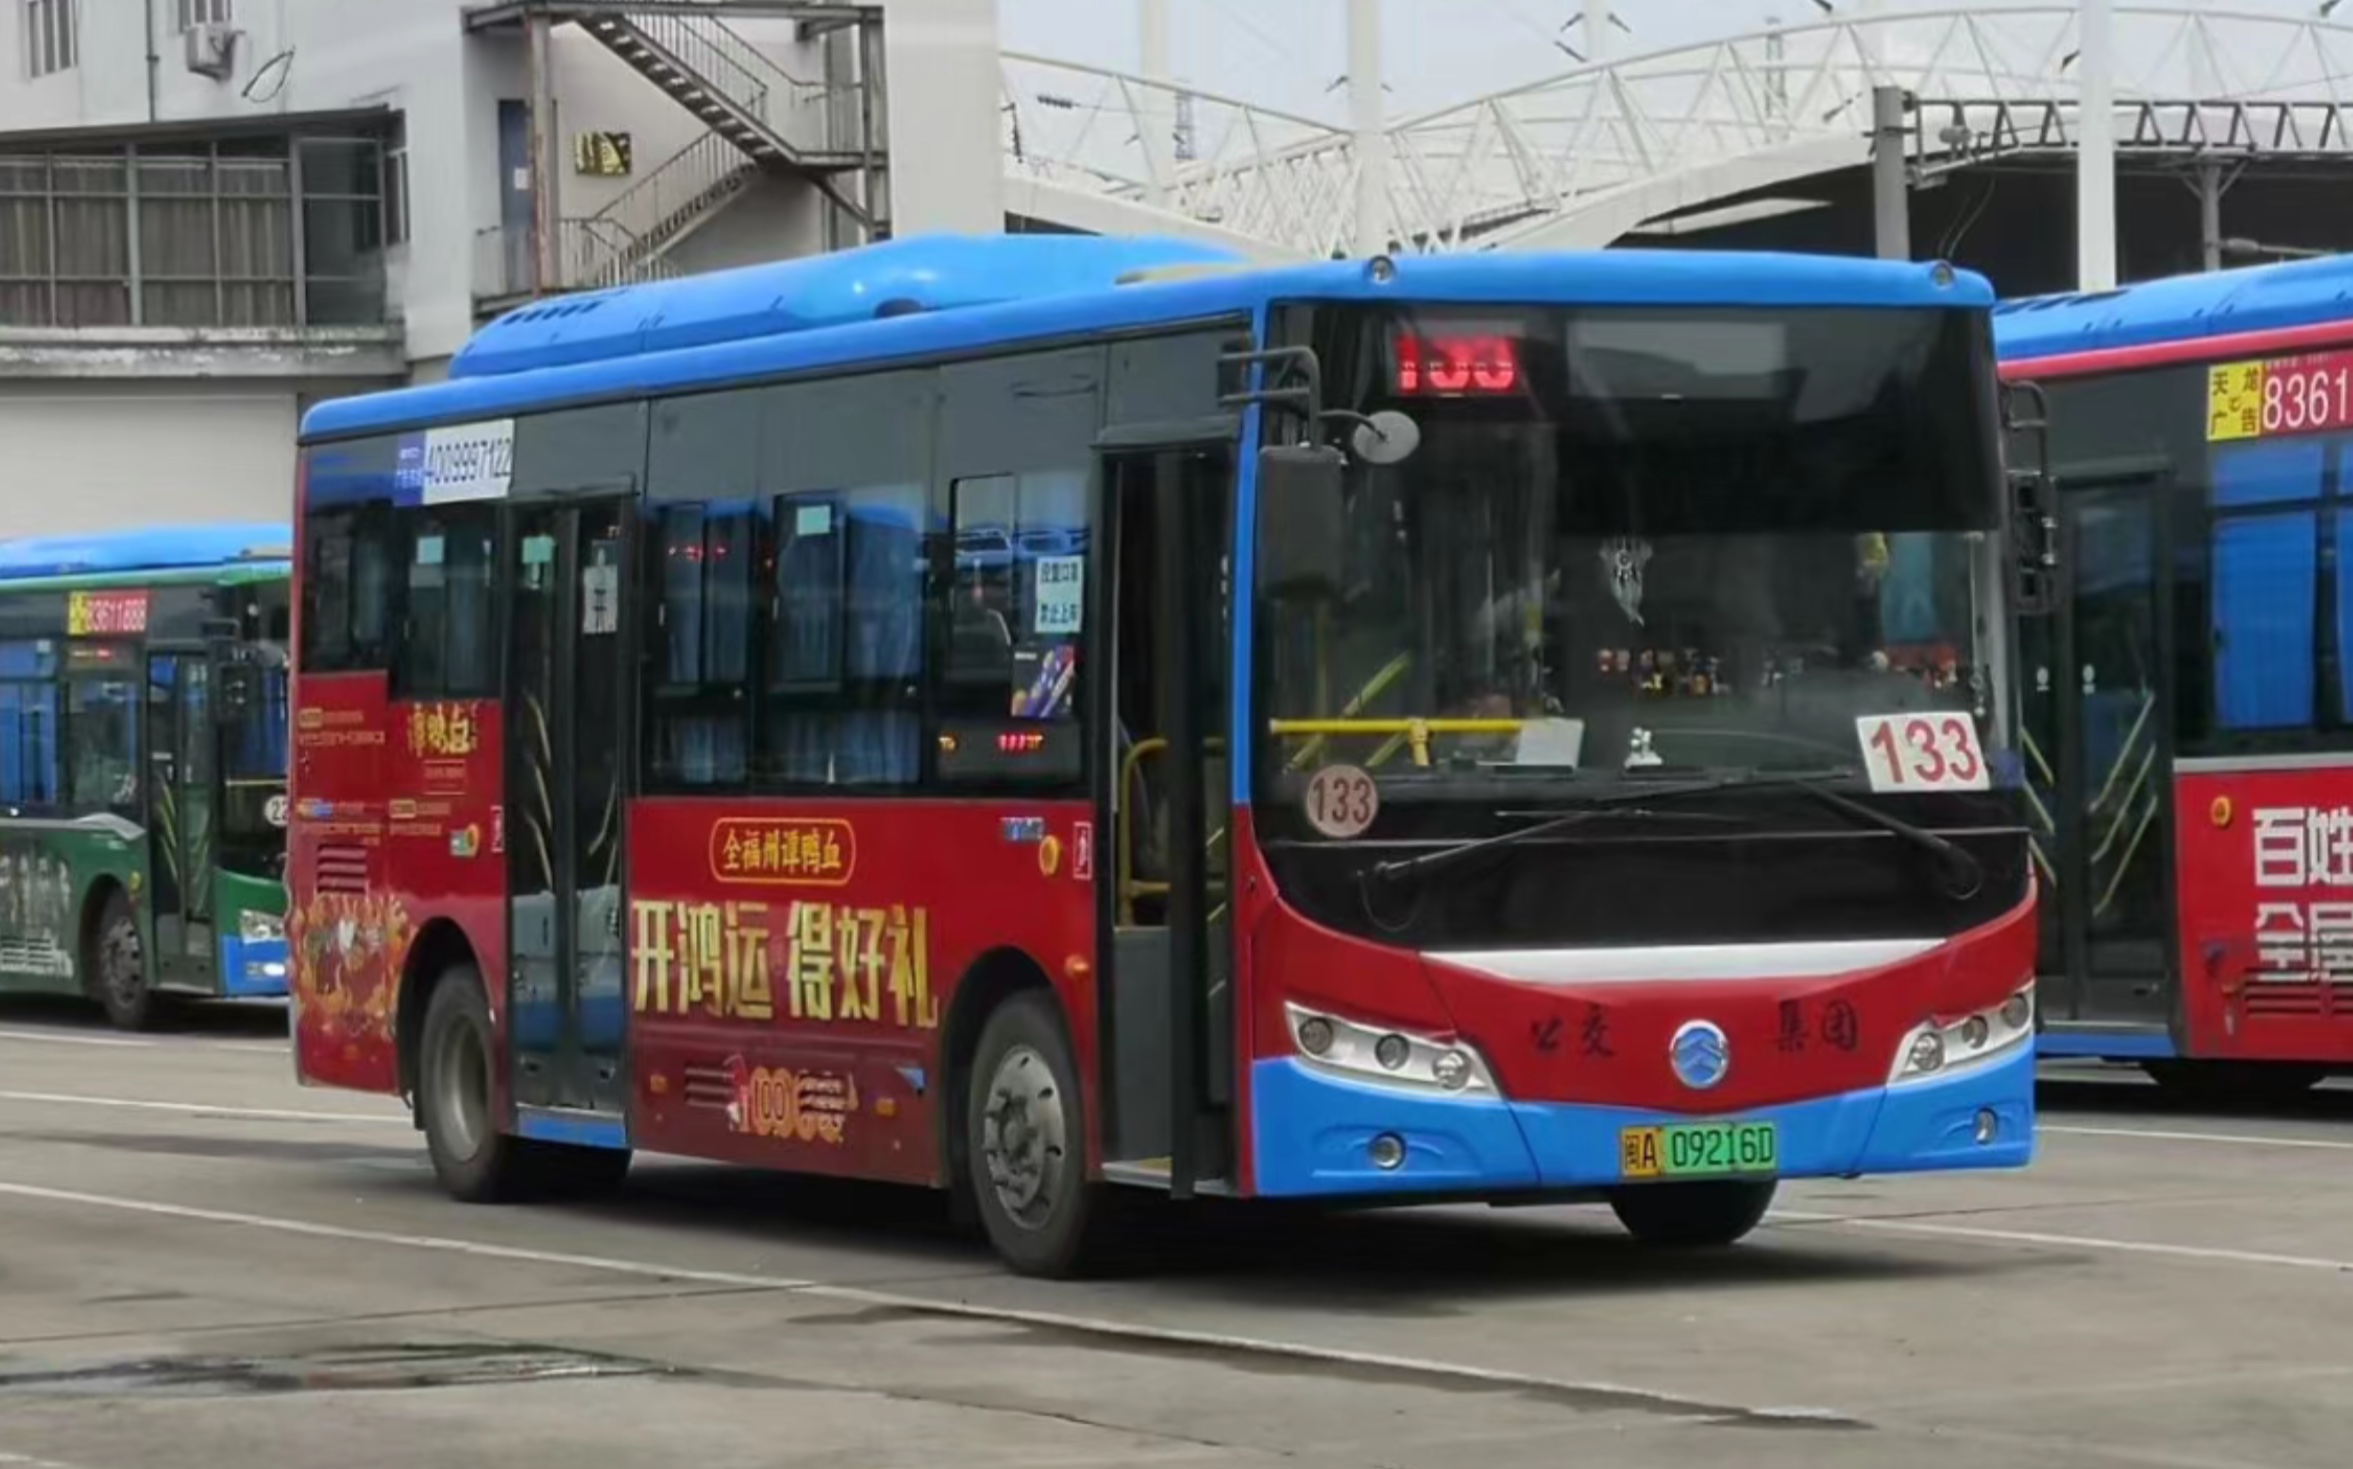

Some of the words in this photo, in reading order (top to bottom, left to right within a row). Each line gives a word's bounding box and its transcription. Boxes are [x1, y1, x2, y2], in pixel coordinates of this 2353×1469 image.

[1870, 719, 1977, 783] 133
[1313, 777, 1371, 824] 133
[632, 900, 773, 1019] 开鸿运
[787, 900, 939, 1028] 得好礼
